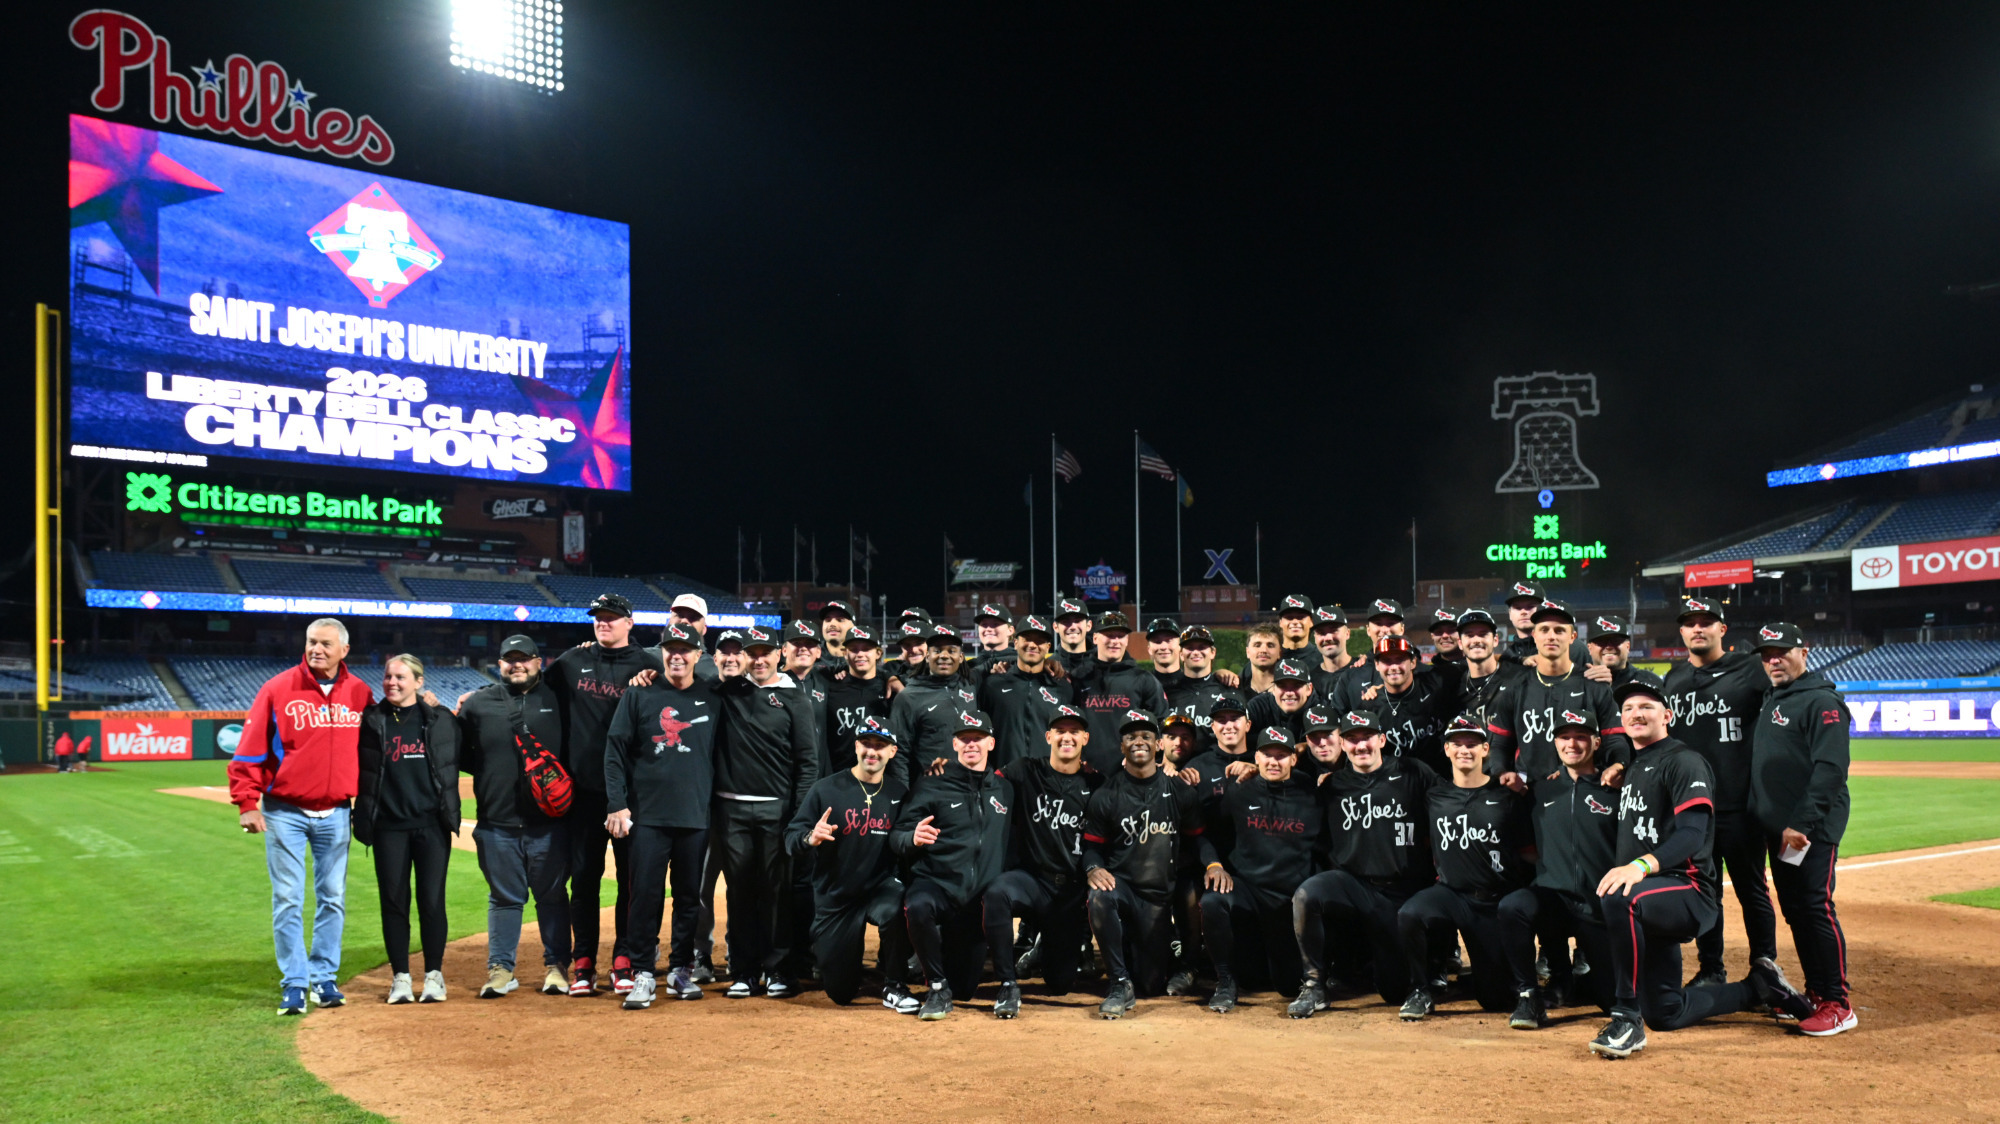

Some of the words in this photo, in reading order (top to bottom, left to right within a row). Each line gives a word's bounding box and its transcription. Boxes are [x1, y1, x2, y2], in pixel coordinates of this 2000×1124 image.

[69, 9, 394, 166] Phillies
[189, 292, 275, 343] SAINT
[278, 306, 405, 361] JOSEPH'S
[408, 323, 548, 379] UNIVERSITY
[325, 367, 428, 402] 2026
[146, 371, 325, 415] LIBERTY
[325, 392, 422, 427] BELL
[422, 404, 576, 442] CLASSIC
[184, 404, 548, 474] CHAMPIONS
[177, 482, 300, 515] Citizens
[306, 492, 378, 521] Bank
[382, 498, 443, 525] Park
[492, 499, 536, 518] GHOST
[1485, 544, 1558, 561] Citizens
[1561, 541, 1607, 559] Bank
[1905, 547, 2000, 575] TOYOT
[955, 559, 1014, 574] Fitzpatrick
[1073, 576, 1087, 586] ALL
[1088, 575, 1106, 585] STAR
[1106, 575, 1127, 585] GAME
[1526, 561, 1567, 578] Park
[104, 711, 170, 719] ASPLUNDH
[183, 711, 246, 719] ASPLUNDH
[837, 706, 856, 736] St.
[1685, 691, 1731, 726] Joe's
[1881, 700, 1988, 731] BELL
[1522, 708, 1546, 743] St.
[1717, 717, 1743, 743] 15
[107, 732, 188, 755] Wawa
[843, 808, 861, 835] St.
[860, 808, 892, 836] Joe's
[1247, 816, 1305, 833] HAWKS
[1341, 796, 1362, 831] St.
[1361, 793, 1408, 829] Joe's
[1139, 809, 1177, 845] Joe's
[1394, 822, 1415, 846] 31
[1436, 816, 1458, 850] St.
[1456, 814, 1501, 849] Joe's
[1633, 816, 1659, 844] 44
[1071, 832, 1083, 855] 1
[1488, 850, 1504, 873] 8
